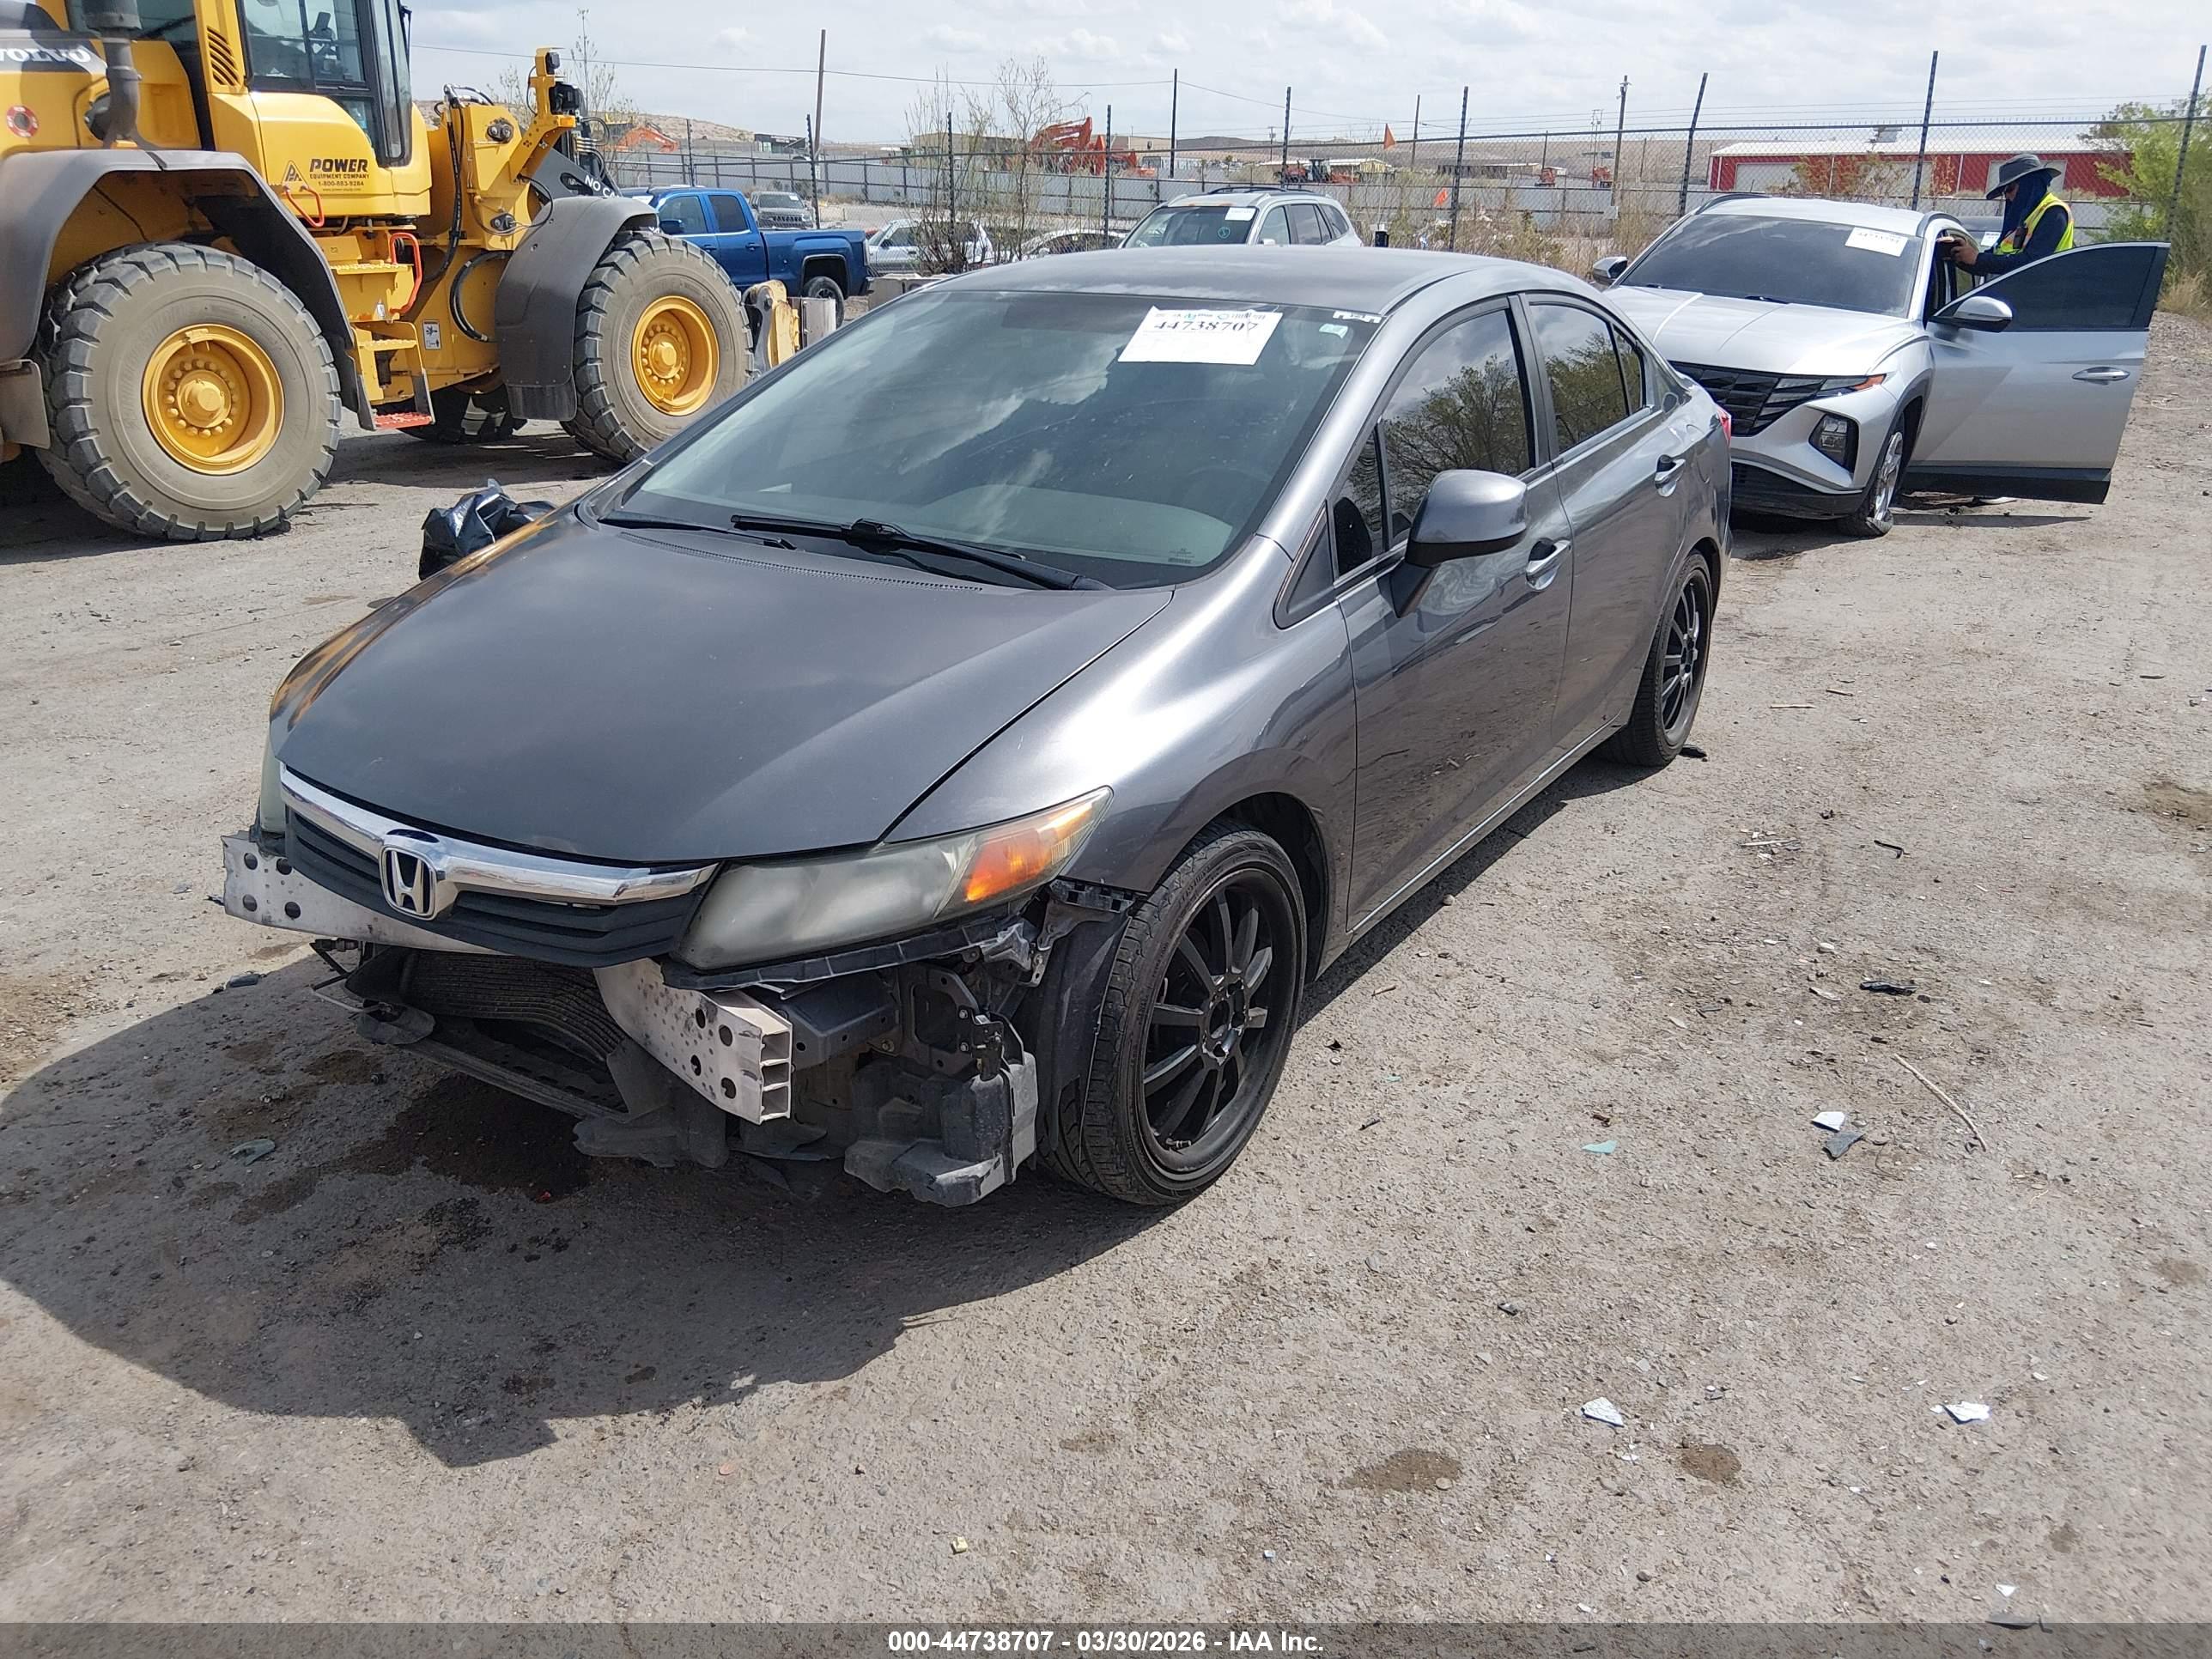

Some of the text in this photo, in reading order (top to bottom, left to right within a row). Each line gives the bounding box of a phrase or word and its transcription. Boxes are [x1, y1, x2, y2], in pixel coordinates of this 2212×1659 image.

[309, 158, 369, 173] POWER
[584, 174, 601, 191] NO
[1153, 320, 1259, 331] 44738707
